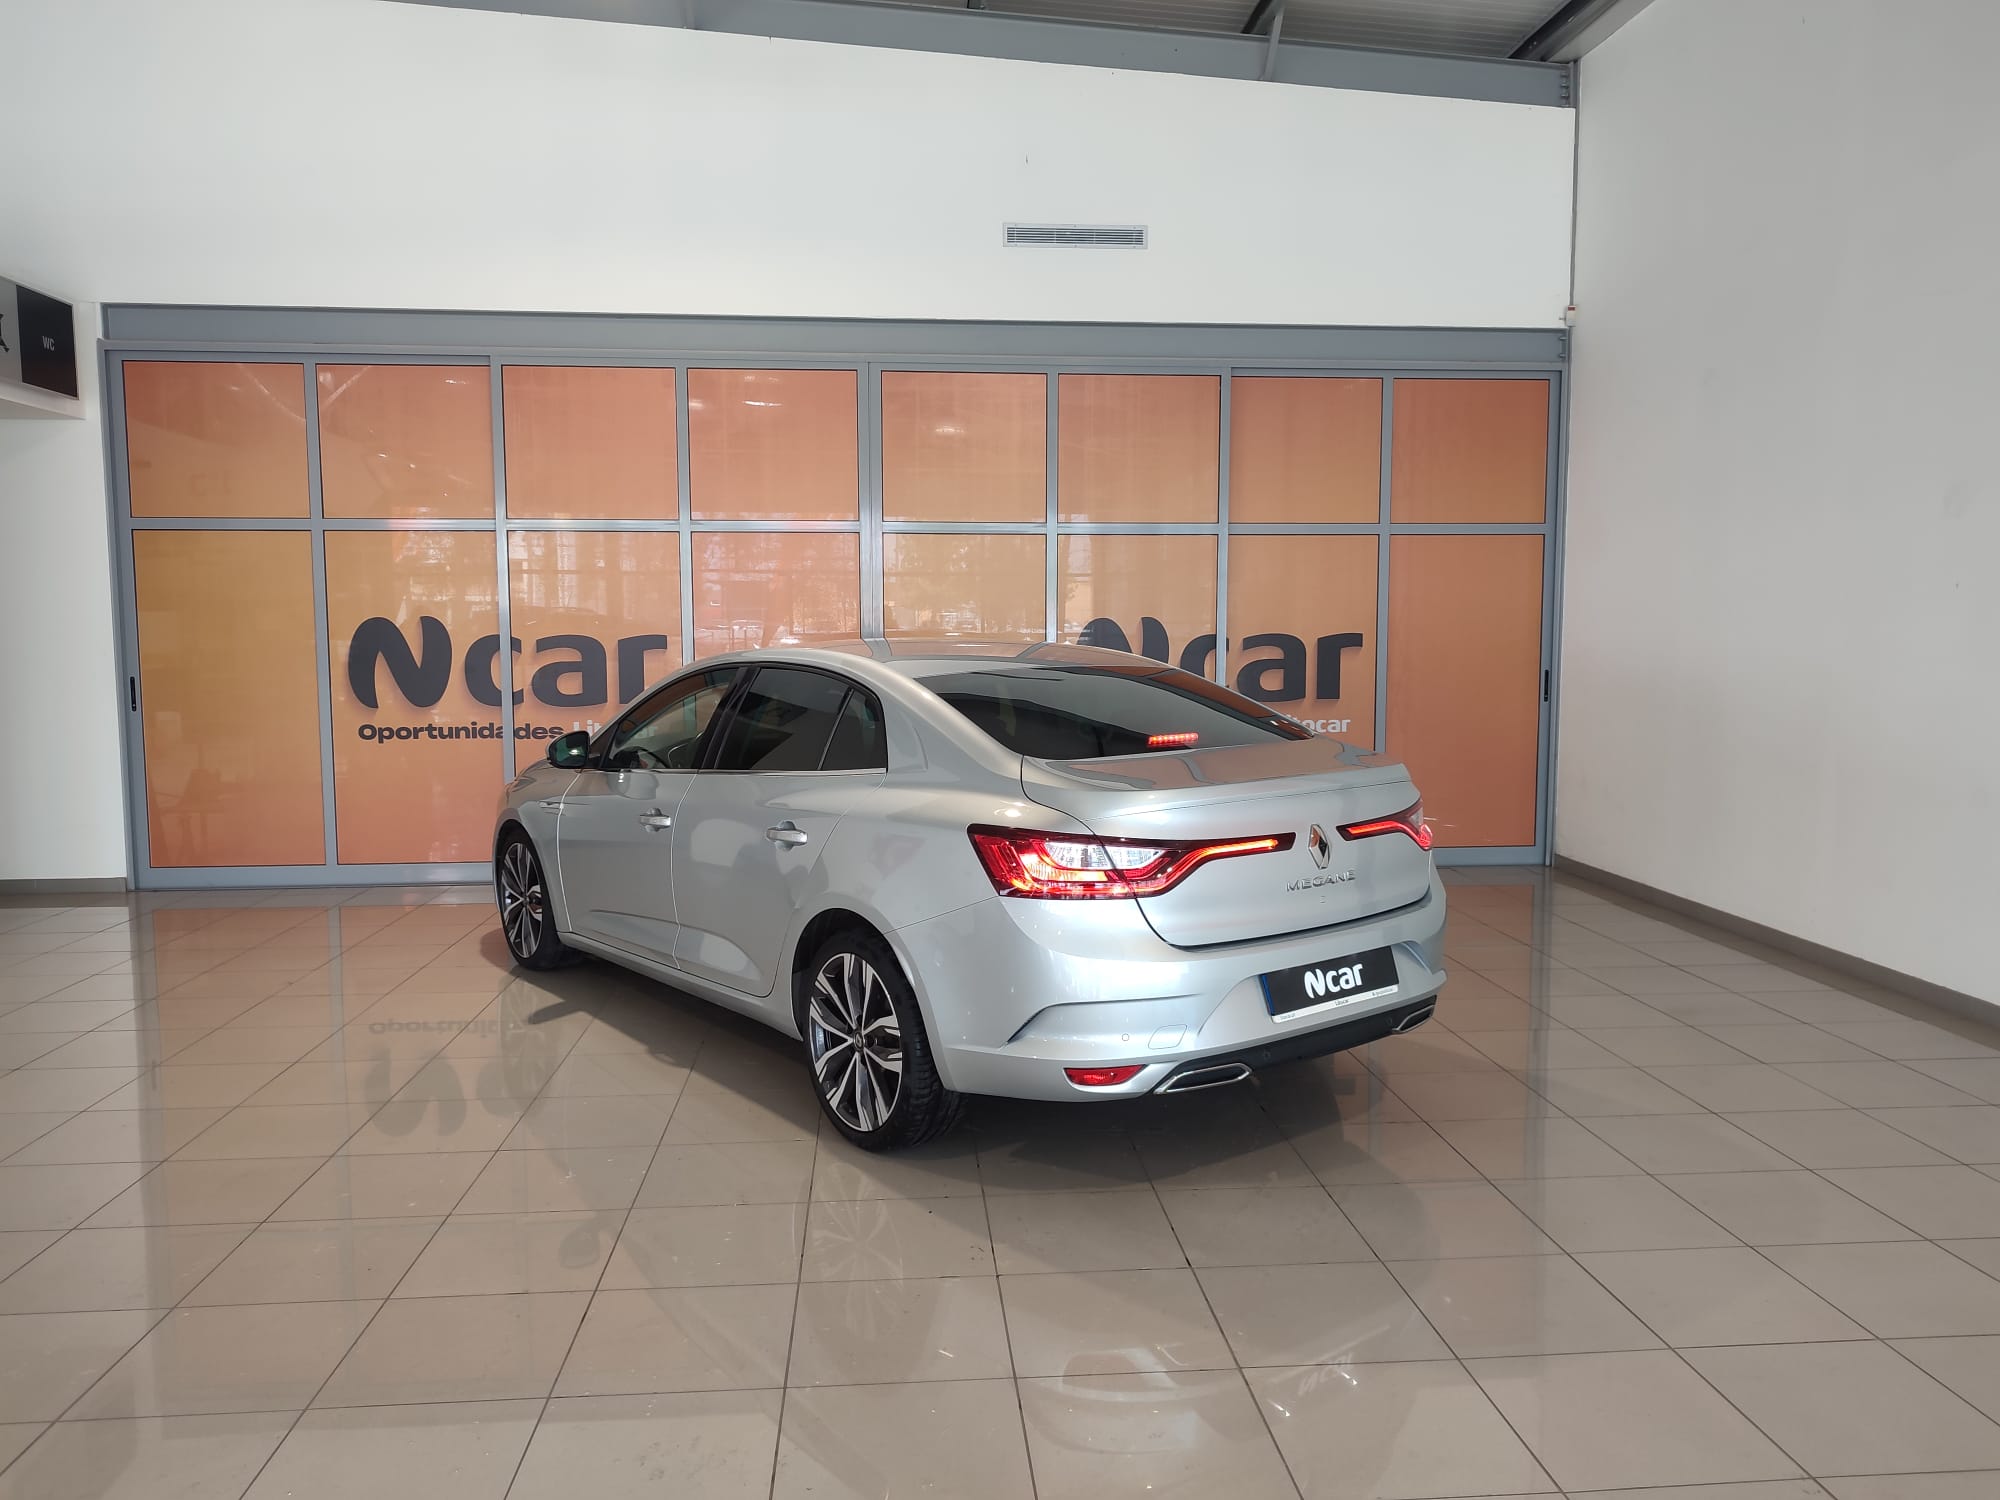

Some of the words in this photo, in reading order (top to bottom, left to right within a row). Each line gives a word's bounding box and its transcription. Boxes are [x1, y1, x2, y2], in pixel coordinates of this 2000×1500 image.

[42, 336, 55, 351] WC
[348, 615, 668, 709] Ncar
[1304, 963, 1363, 998] Ncar
